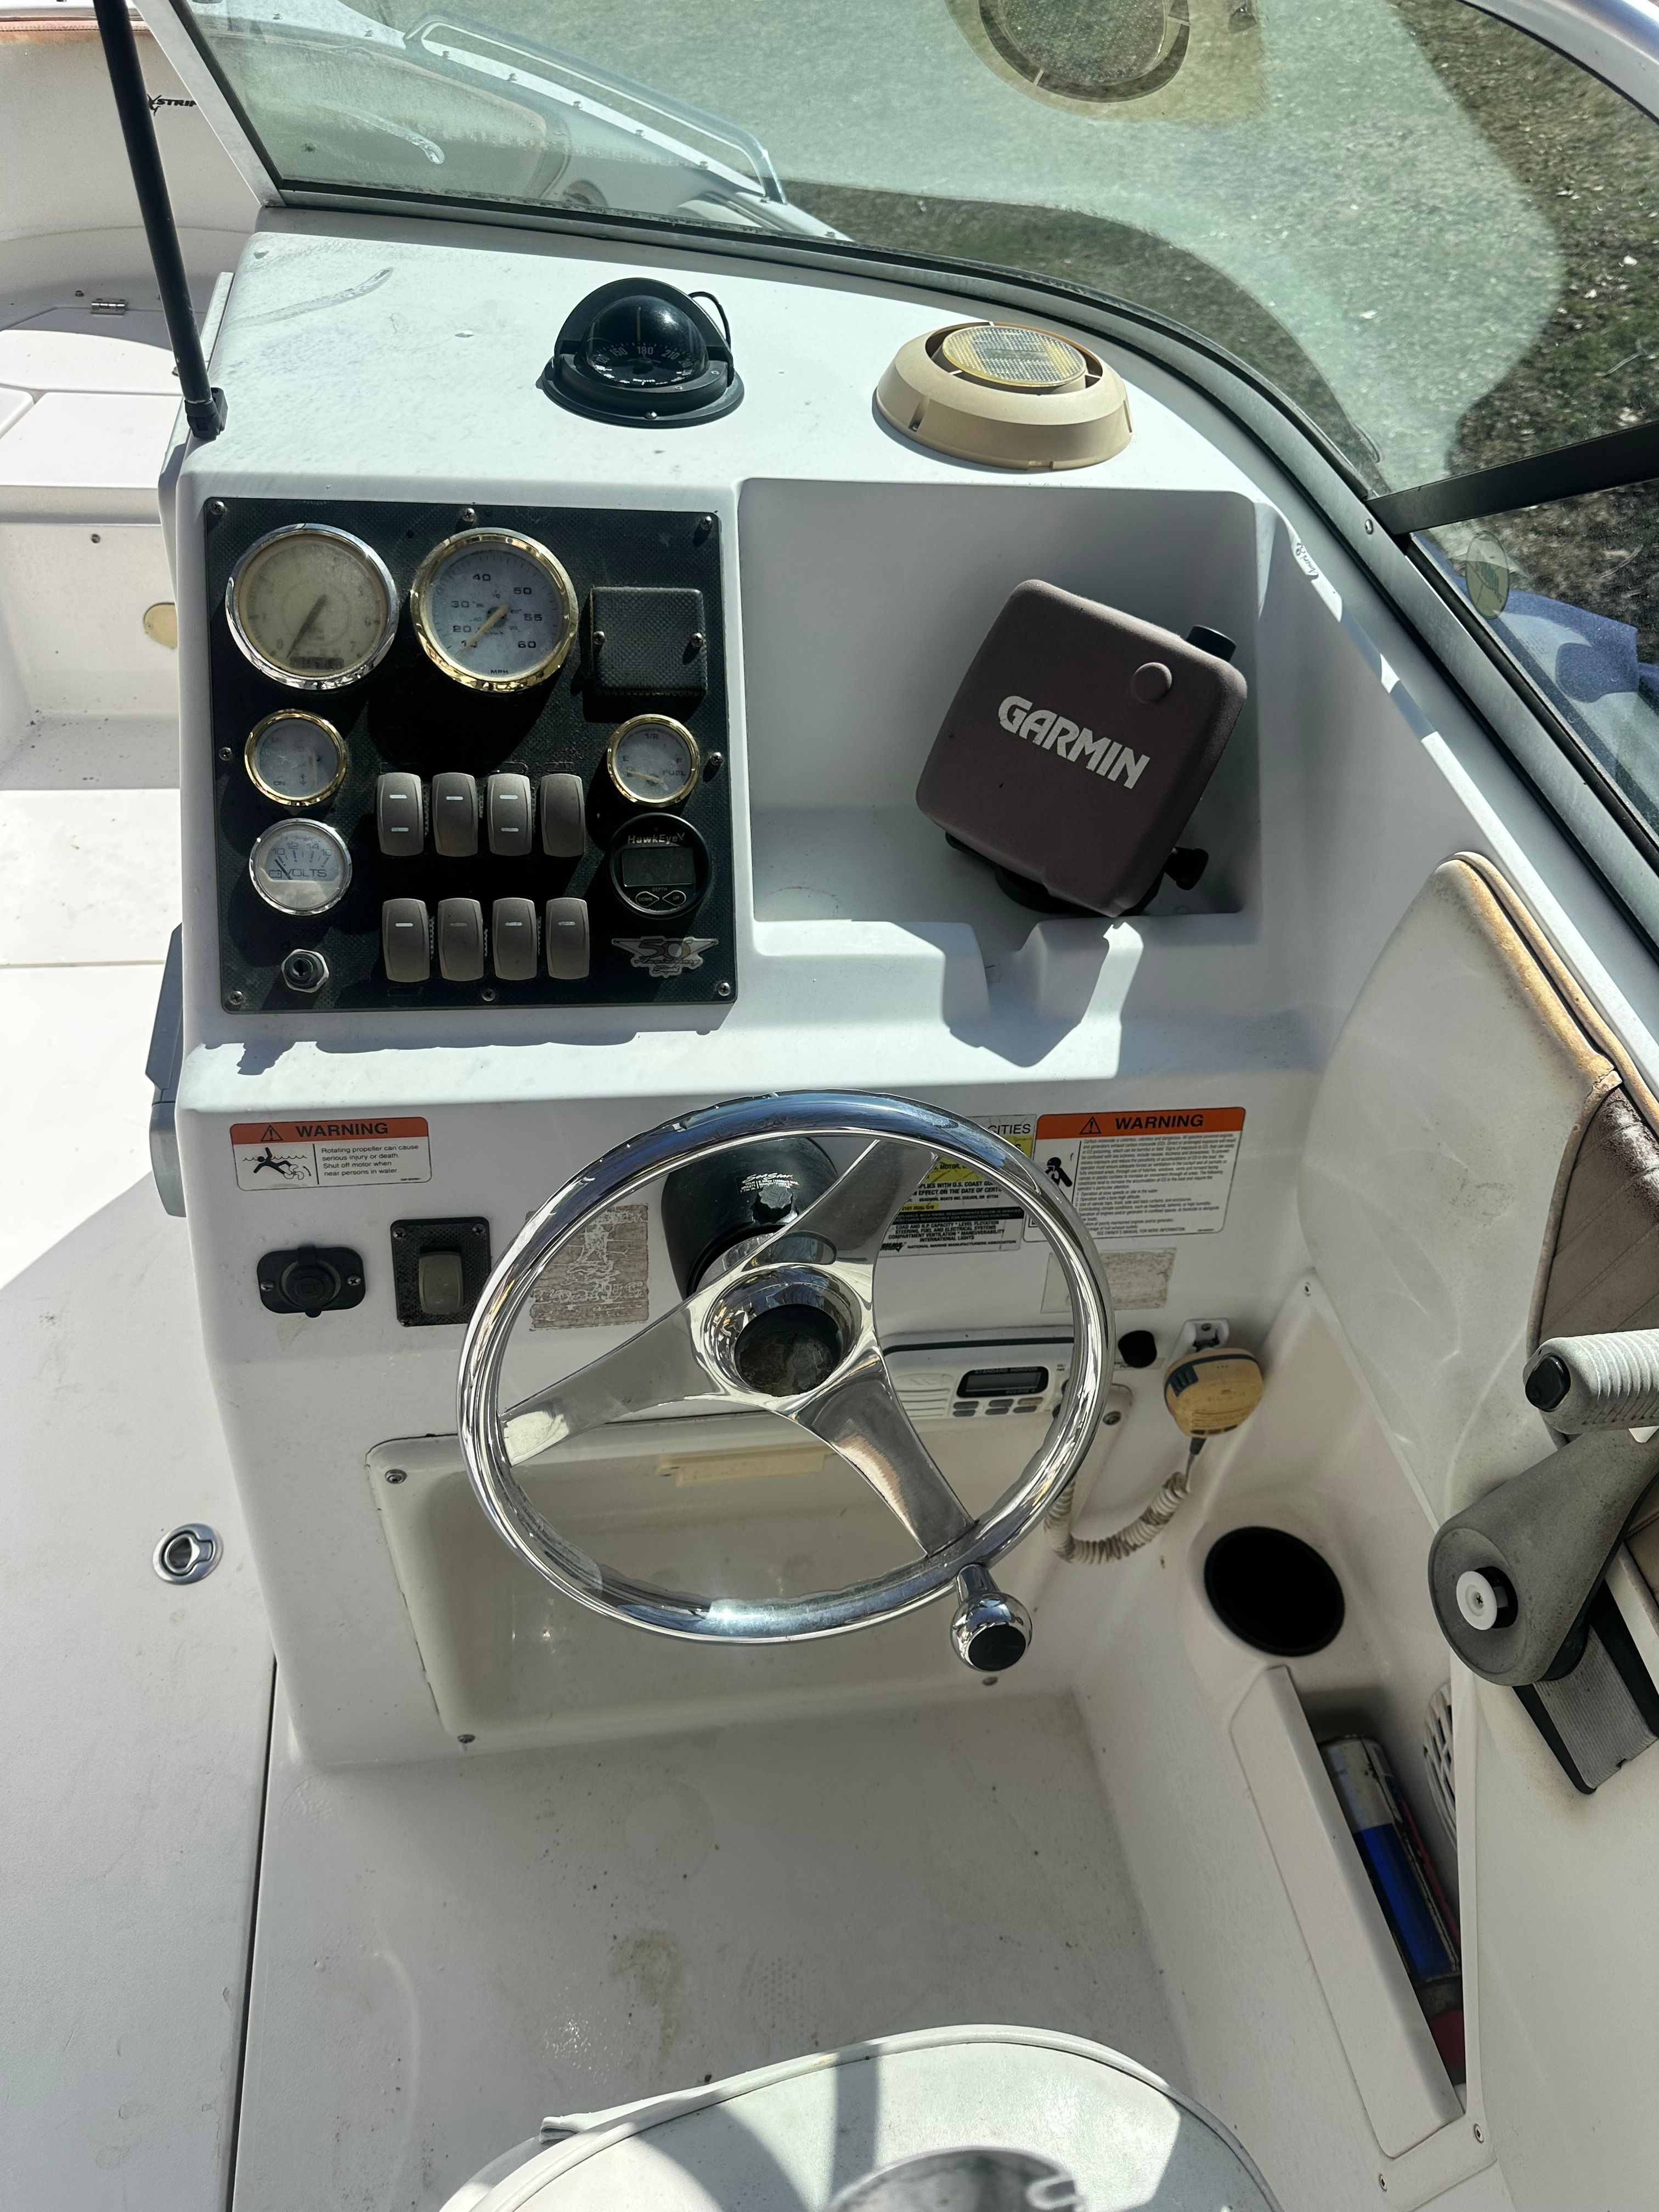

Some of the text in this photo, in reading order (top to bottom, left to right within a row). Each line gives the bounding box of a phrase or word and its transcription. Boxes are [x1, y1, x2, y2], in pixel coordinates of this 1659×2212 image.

[609, 347, 628, 357] 150
[637, 346, 653, 354] 180
[661, 349, 680, 360] 210
[998, 696, 1150, 789] GARMIN
[628, 834, 678, 845] HawkEye
[273, 848, 285, 856] 10
[286, 869, 327, 877] VOLTS
[639, 939, 691, 960] 50
[1115, 1114, 1204, 1130] WARNING
[295, 1122, 388, 1137] WARNING
[988, 1124, 1031, 1135] CITIES
[742, 1172, 793, 1184] SeaStar
